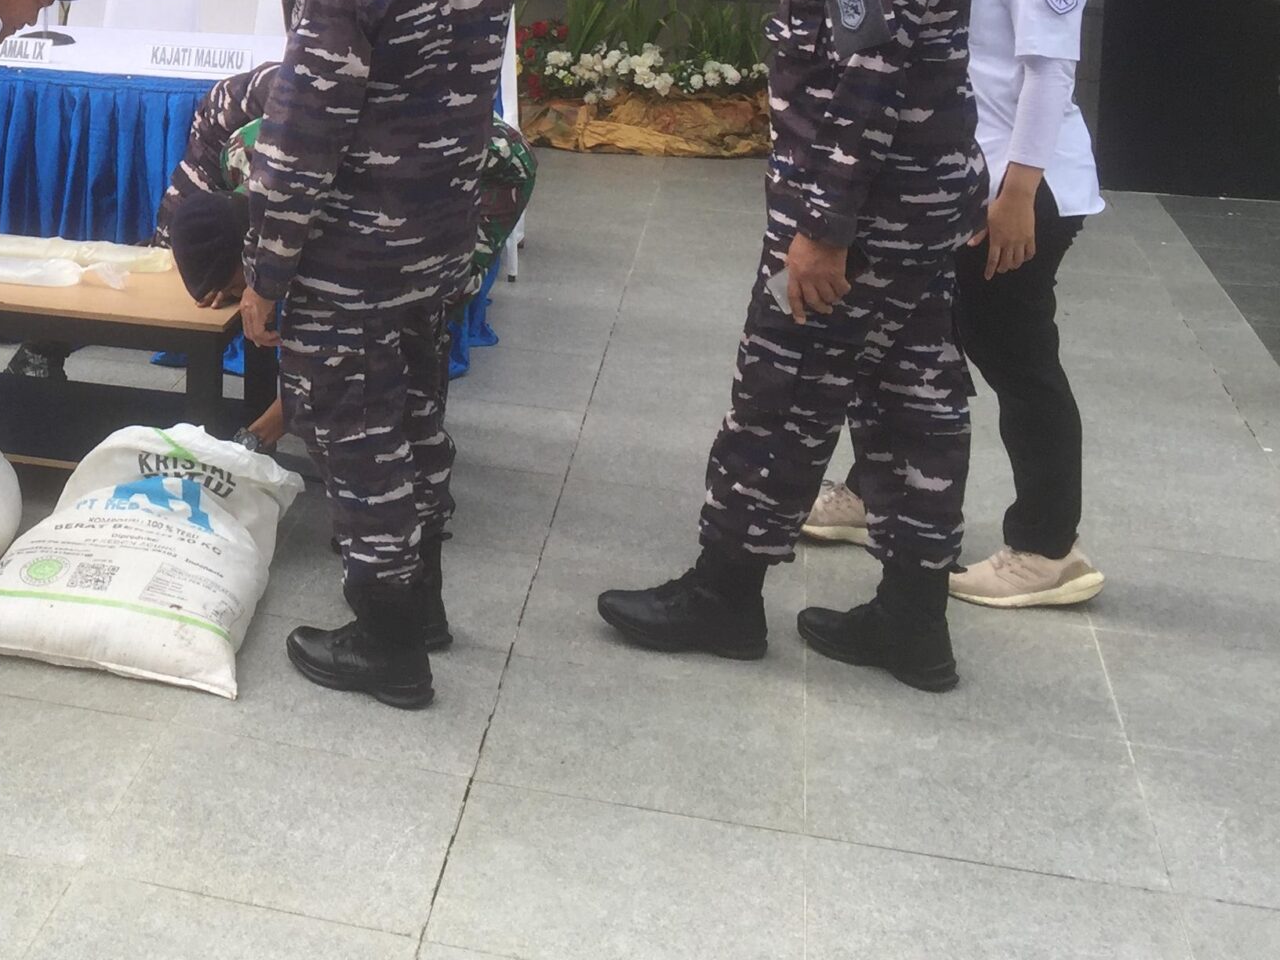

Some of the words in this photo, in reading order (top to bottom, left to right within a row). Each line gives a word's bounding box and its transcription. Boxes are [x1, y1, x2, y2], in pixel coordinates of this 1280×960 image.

[32, 41, 46, 61] IX
[150, 46, 192, 66] KAJATI
[194, 48, 245, 70] MALUKU
[146, 519, 164, 530] 100
[202, 541, 223, 556] KG
